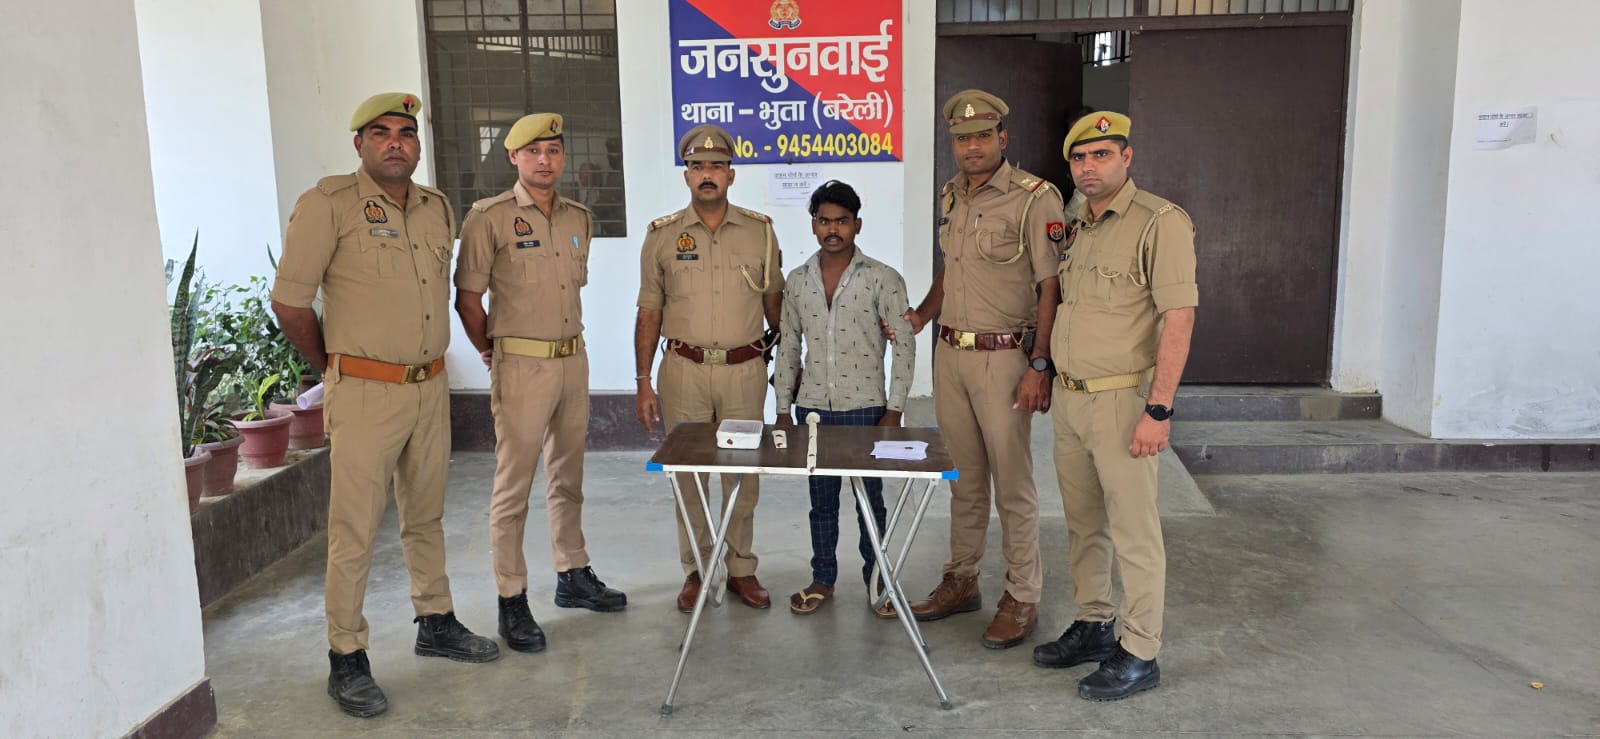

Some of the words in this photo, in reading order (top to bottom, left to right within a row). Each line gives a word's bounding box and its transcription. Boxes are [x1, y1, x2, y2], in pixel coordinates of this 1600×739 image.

[678, 19, 893, 93] जनसुनवाई
[681, 102, 735, 123] थाना
[758, 100, 807, 130] भुता
[812, 90, 894, 129] (बरेली)
[776, 132, 894, 158] 9454403084
